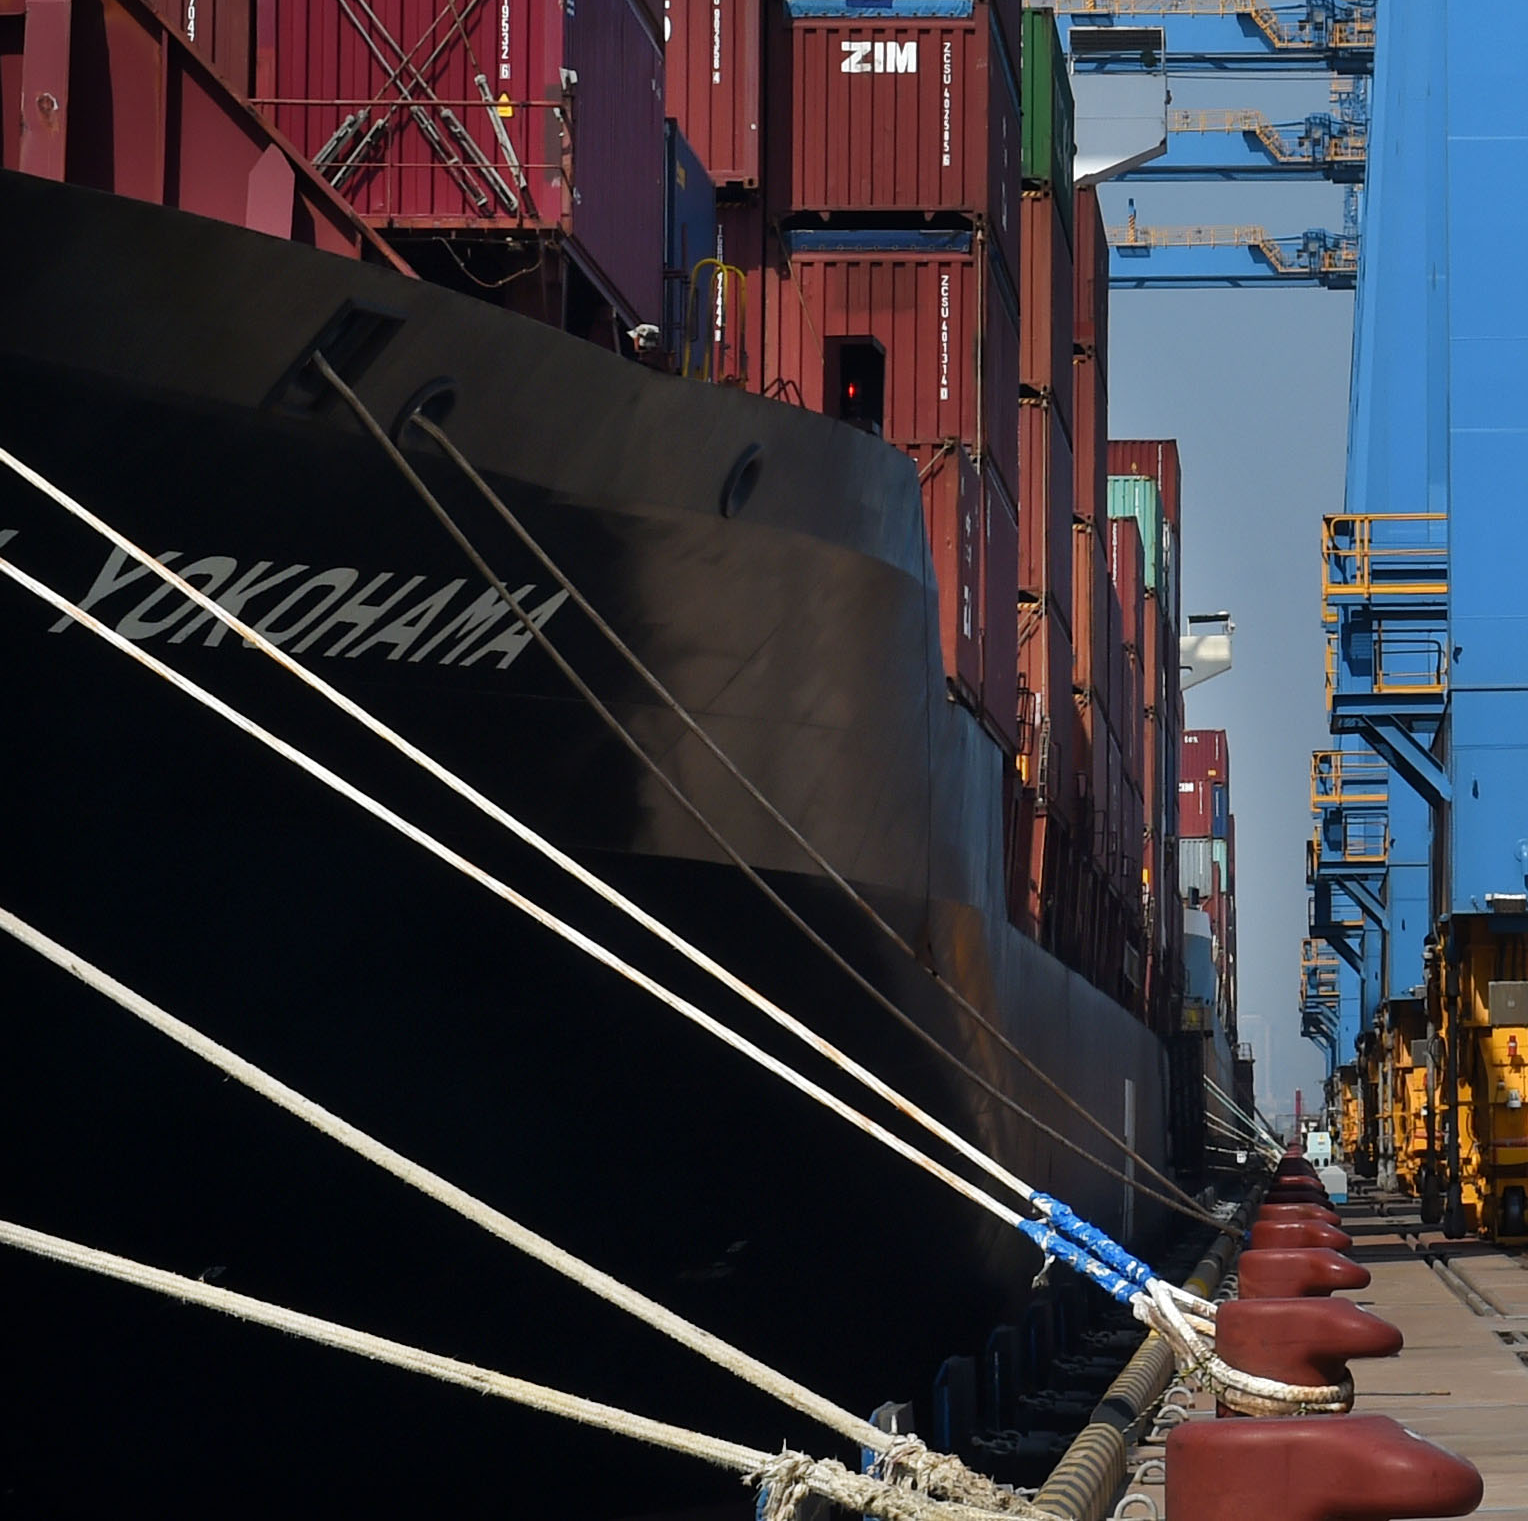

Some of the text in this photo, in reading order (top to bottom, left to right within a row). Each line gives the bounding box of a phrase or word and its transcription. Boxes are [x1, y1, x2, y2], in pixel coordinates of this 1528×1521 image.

[500, 63, 511, 79] 6
[840, 41, 918, 74] ZIM
[943, 41, 952, 84] ZCSU
[941, 274, 949, 318] ZCSU
[941, 320, 949, 386] 401314
[48, 549, 571, 670] YOKOHAMA
